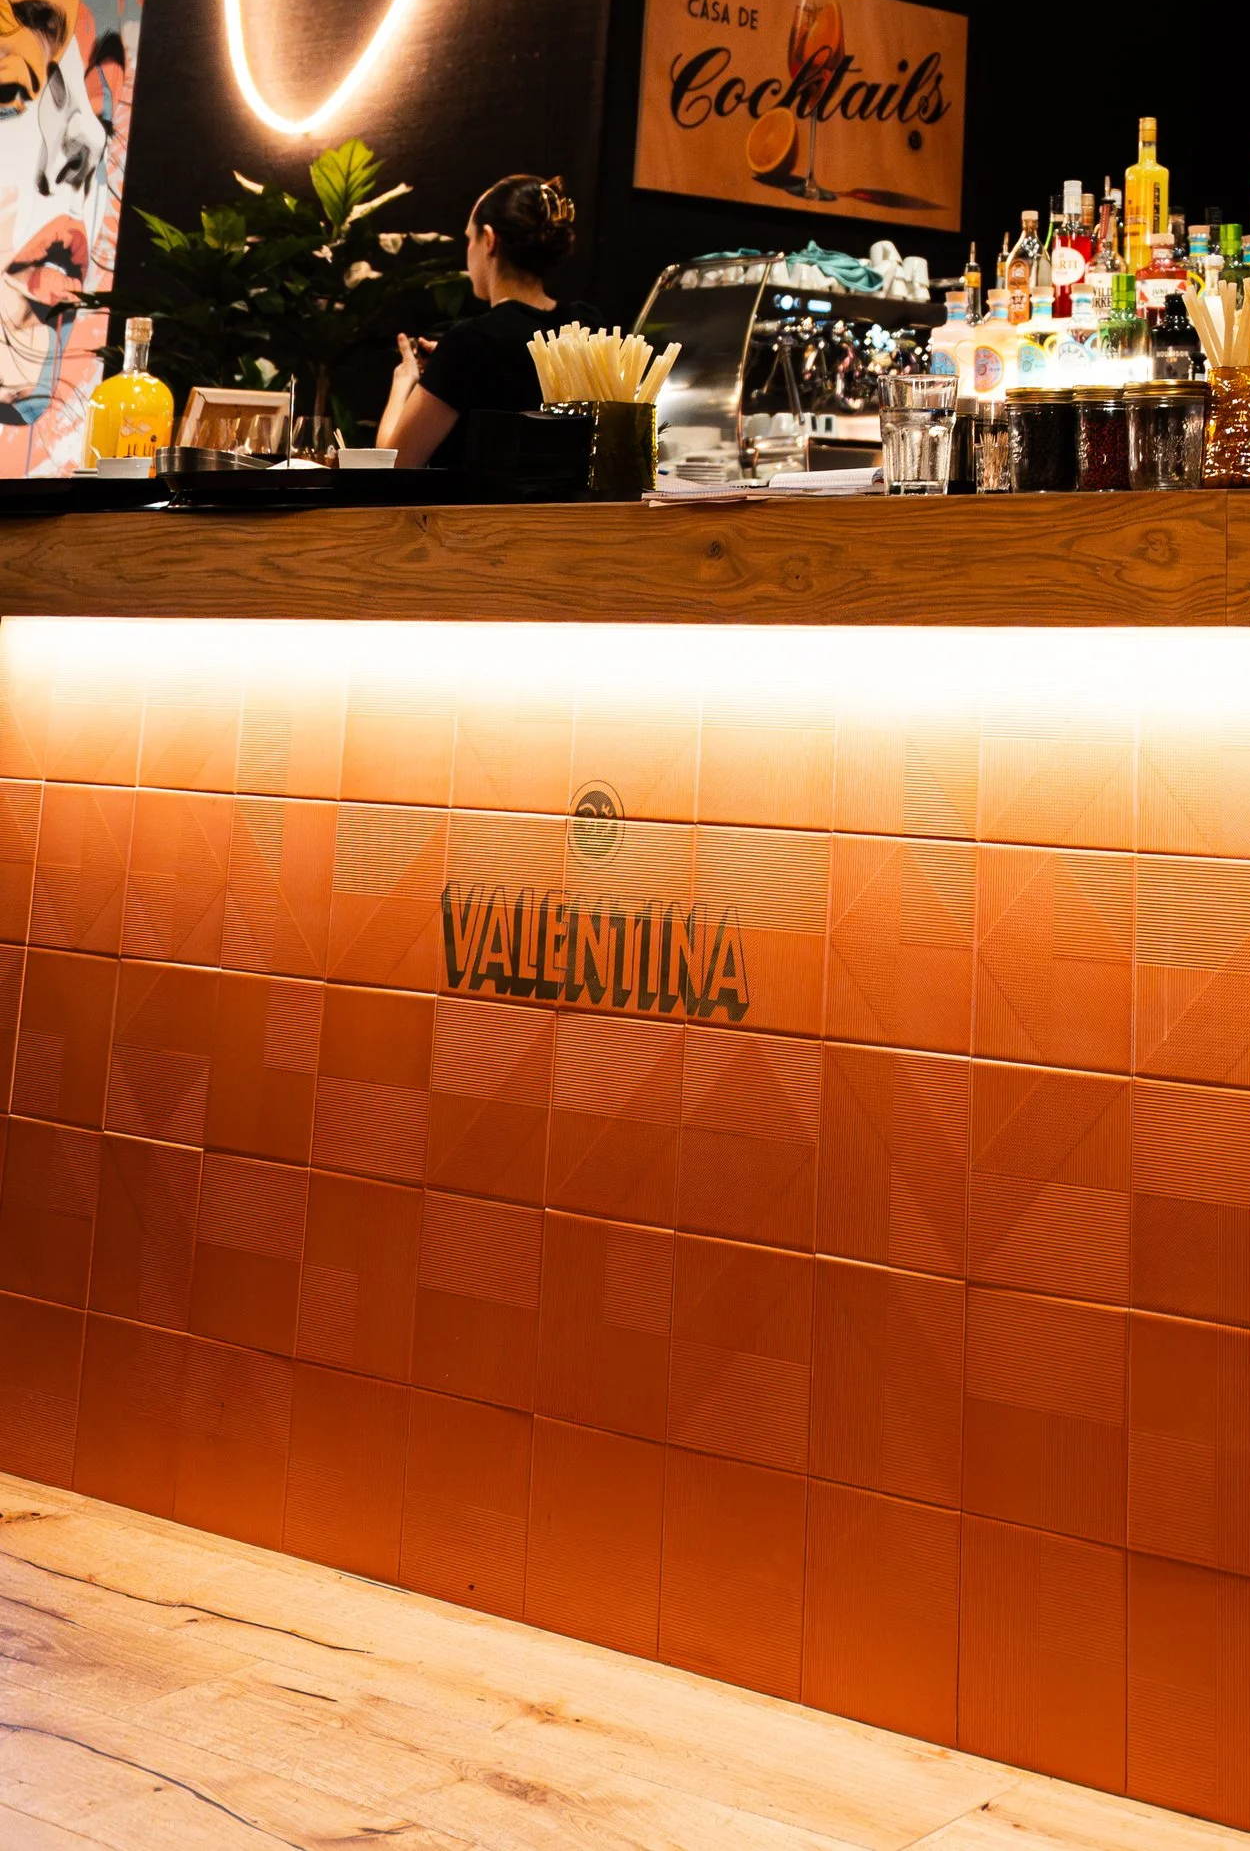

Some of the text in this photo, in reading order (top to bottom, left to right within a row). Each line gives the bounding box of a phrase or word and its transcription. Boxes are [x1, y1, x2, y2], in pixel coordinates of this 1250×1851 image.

[738, 5, 759, 31] DE
[669, 44, 952, 130] Cocktails
[441, 881, 749, 1022] VALENTINA
